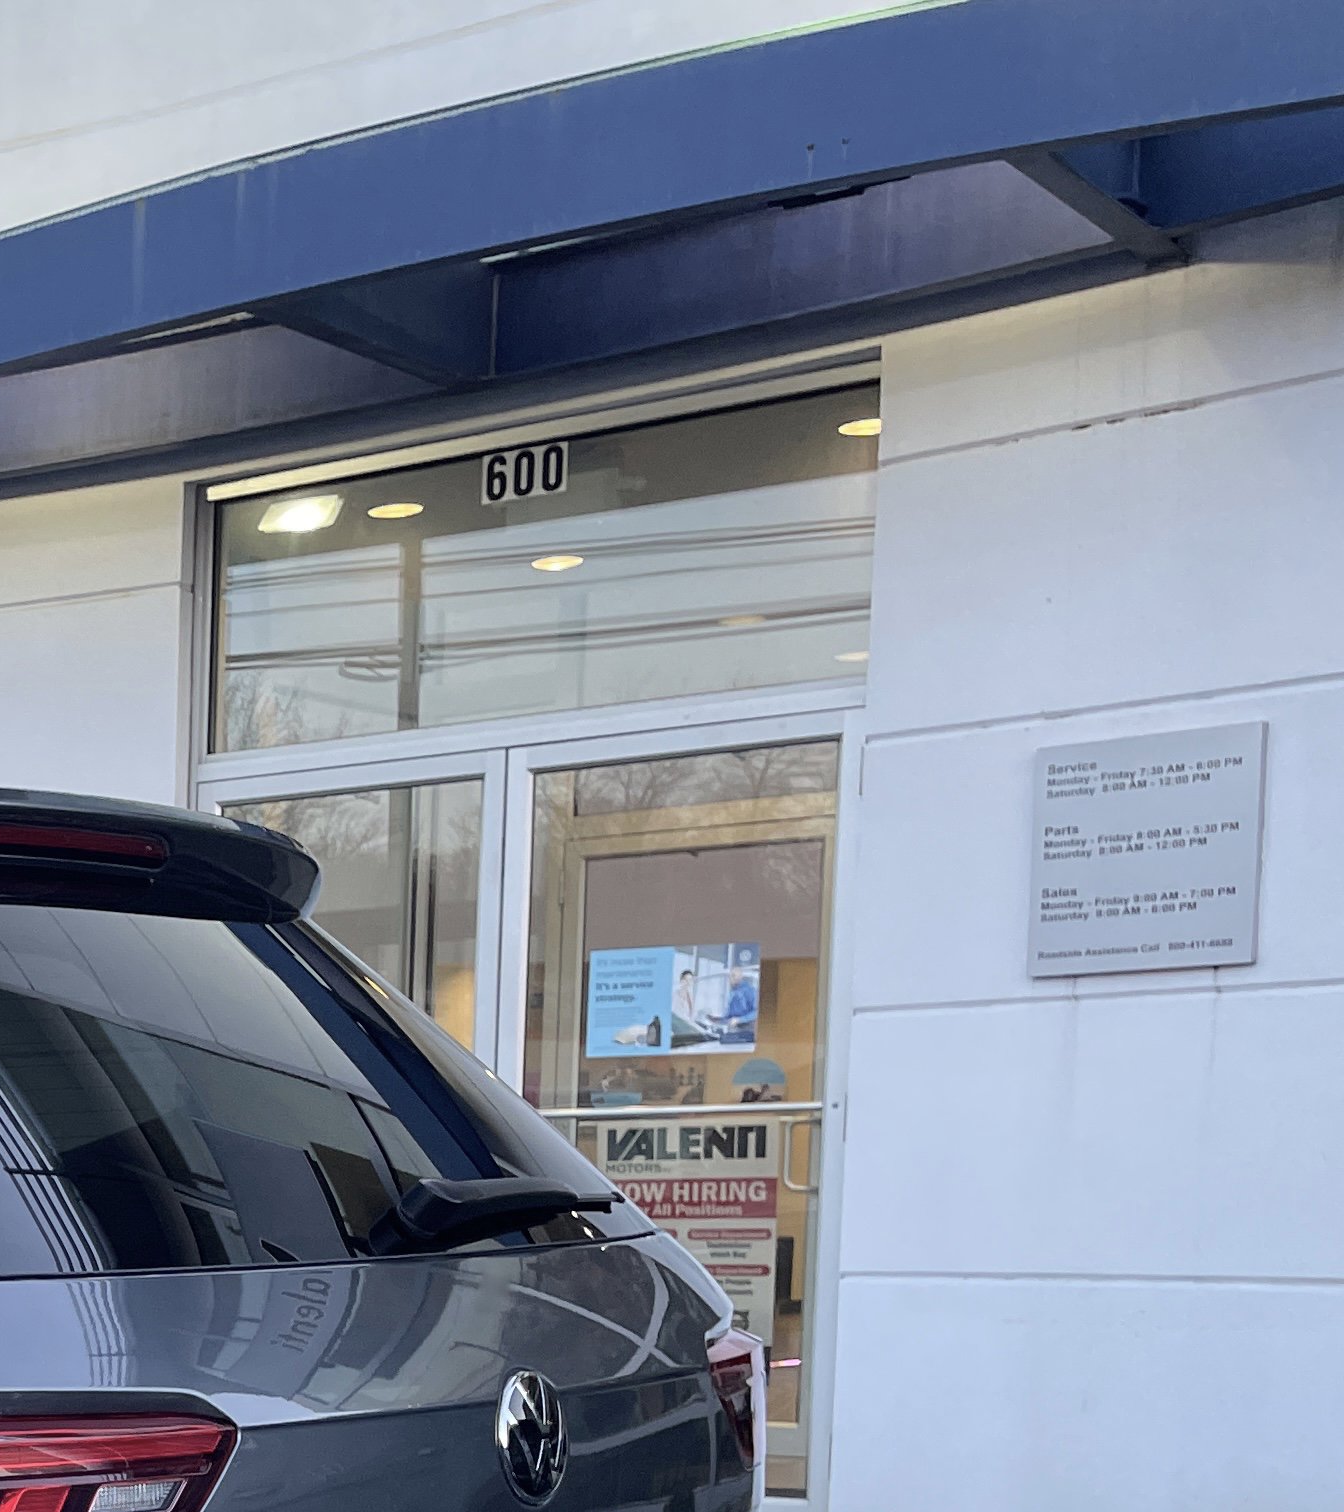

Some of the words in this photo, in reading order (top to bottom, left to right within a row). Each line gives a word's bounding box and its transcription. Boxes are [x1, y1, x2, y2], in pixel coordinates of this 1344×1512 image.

[486, 444, 564, 501] 600
[1047, 762, 1097, 775] Service
[1047, 776, 1090, 787] Monday
[1100, 771, 1136, 781] Friday
[1167, 763, 1185, 774] AM
[1224, 757, 1243, 768] PM
[1046, 786, 1095, 799] Saturday
[1130, 779, 1147, 790] AM
[1159, 775, 1189, 786] 12:00
[1192, 773, 1211, 783] PM
[1043, 837, 1087, 849] Monday
[1097, 833, 1133, 845] Friday
[1164, 827, 1182, 837] AM
[1221, 822, 1240, 832] PM
[1044, 825, 1079, 837] Parts
[1043, 848, 1092, 861] Saturday
[1125, 843, 1144, 853] AM
[1156, 838, 1186, 850] 12:00
[1189, 836, 1208, 847] PM
[1041, 887, 1077, 898] Sales
[1041, 899, 1085, 911] Monday
[1094, 895, 1130, 908] Friday
[1160, 890, 1179, 901] AM
[1217, 886, 1236, 897] PM
[1040, 911, 1089, 923] Saturday
[1122, 906, 1141, 916] AM
[1179, 901, 1197, 911] PM
[607, 1125, 767, 1161] VALENTI
[605, 1162, 661, 1174] MOTORS
[672, 1181, 767, 1203] HIRING
[652, 1203, 671, 1216] All
[675, 1204, 743, 1217] Positions
